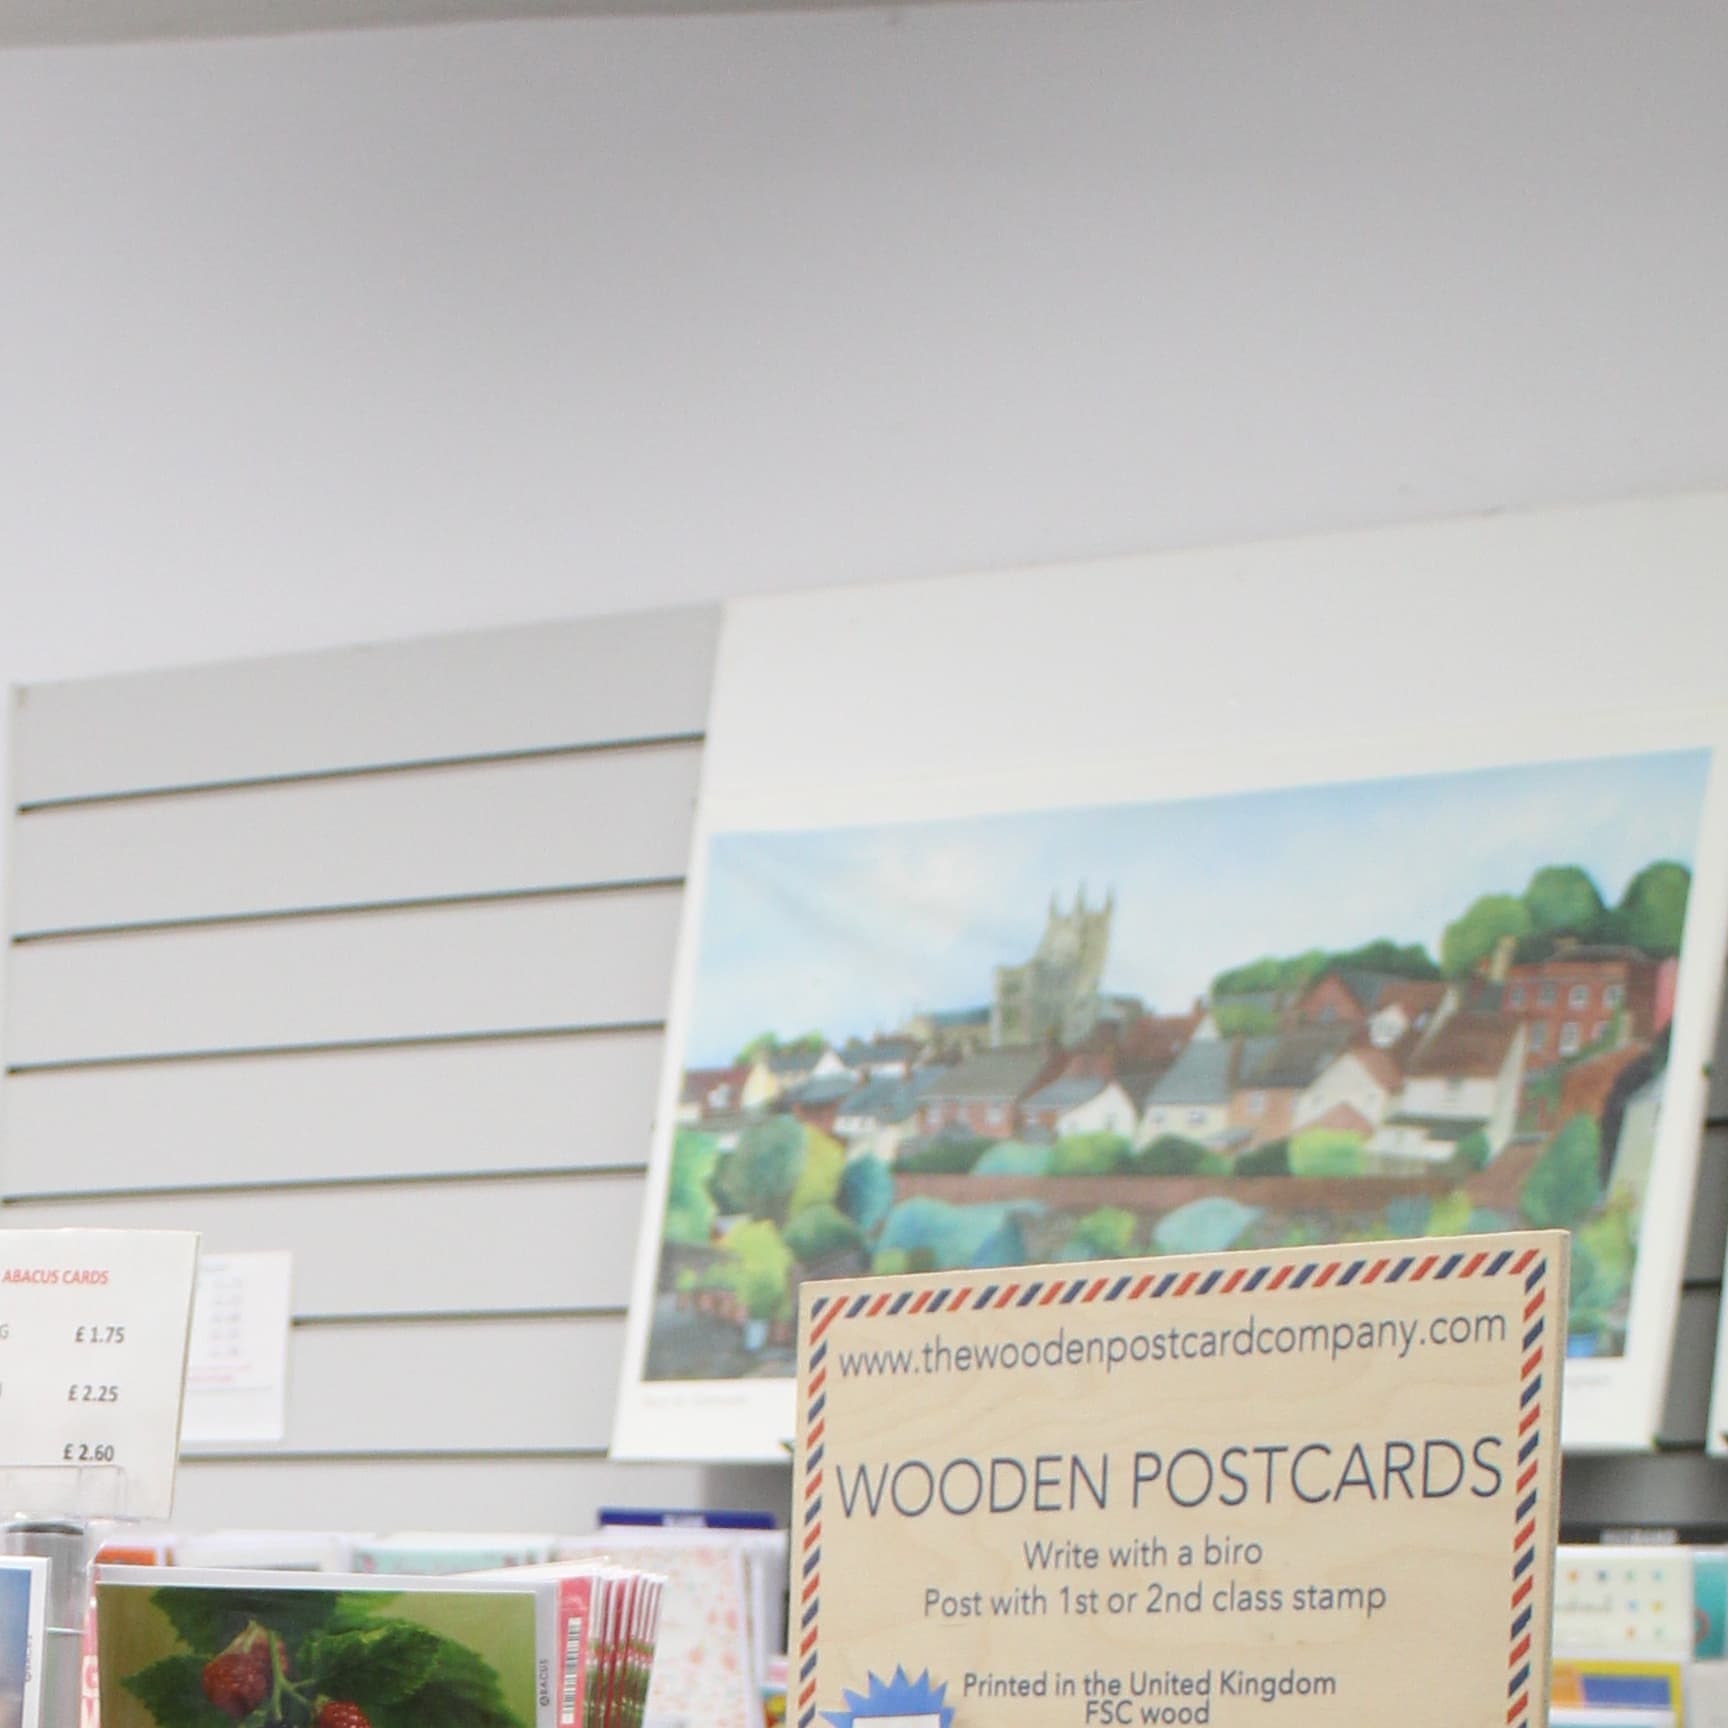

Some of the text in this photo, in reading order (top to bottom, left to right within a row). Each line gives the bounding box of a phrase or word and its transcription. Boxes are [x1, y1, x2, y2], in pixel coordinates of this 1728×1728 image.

[2, 1267, 109, 1287] ABACUS CARDS
[75, 1326, 85, 1344] £
[90, 1326, 125, 1344] 1.75
[839, 1311, 1507, 1378] www.thewoodenpostcardcompany.com
[69, 1385, 78, 1403] £
[83, 1385, 118, 1402] 2.25
[63, 1443, 73, 1462] £
[78, 1443, 115, 1462] 2.60
[836, 1435, 1502, 1519] WOODEN POSTCARDS
[1024, 1537, 1263, 1569] Write with a biro
[924, 1583, 1387, 1618] Post with 1st or 2nd class stamp
[962, 1671, 1336, 1703] Printed in the United Kingdom
[1085, 1699, 1210, 1726] FSC wood
